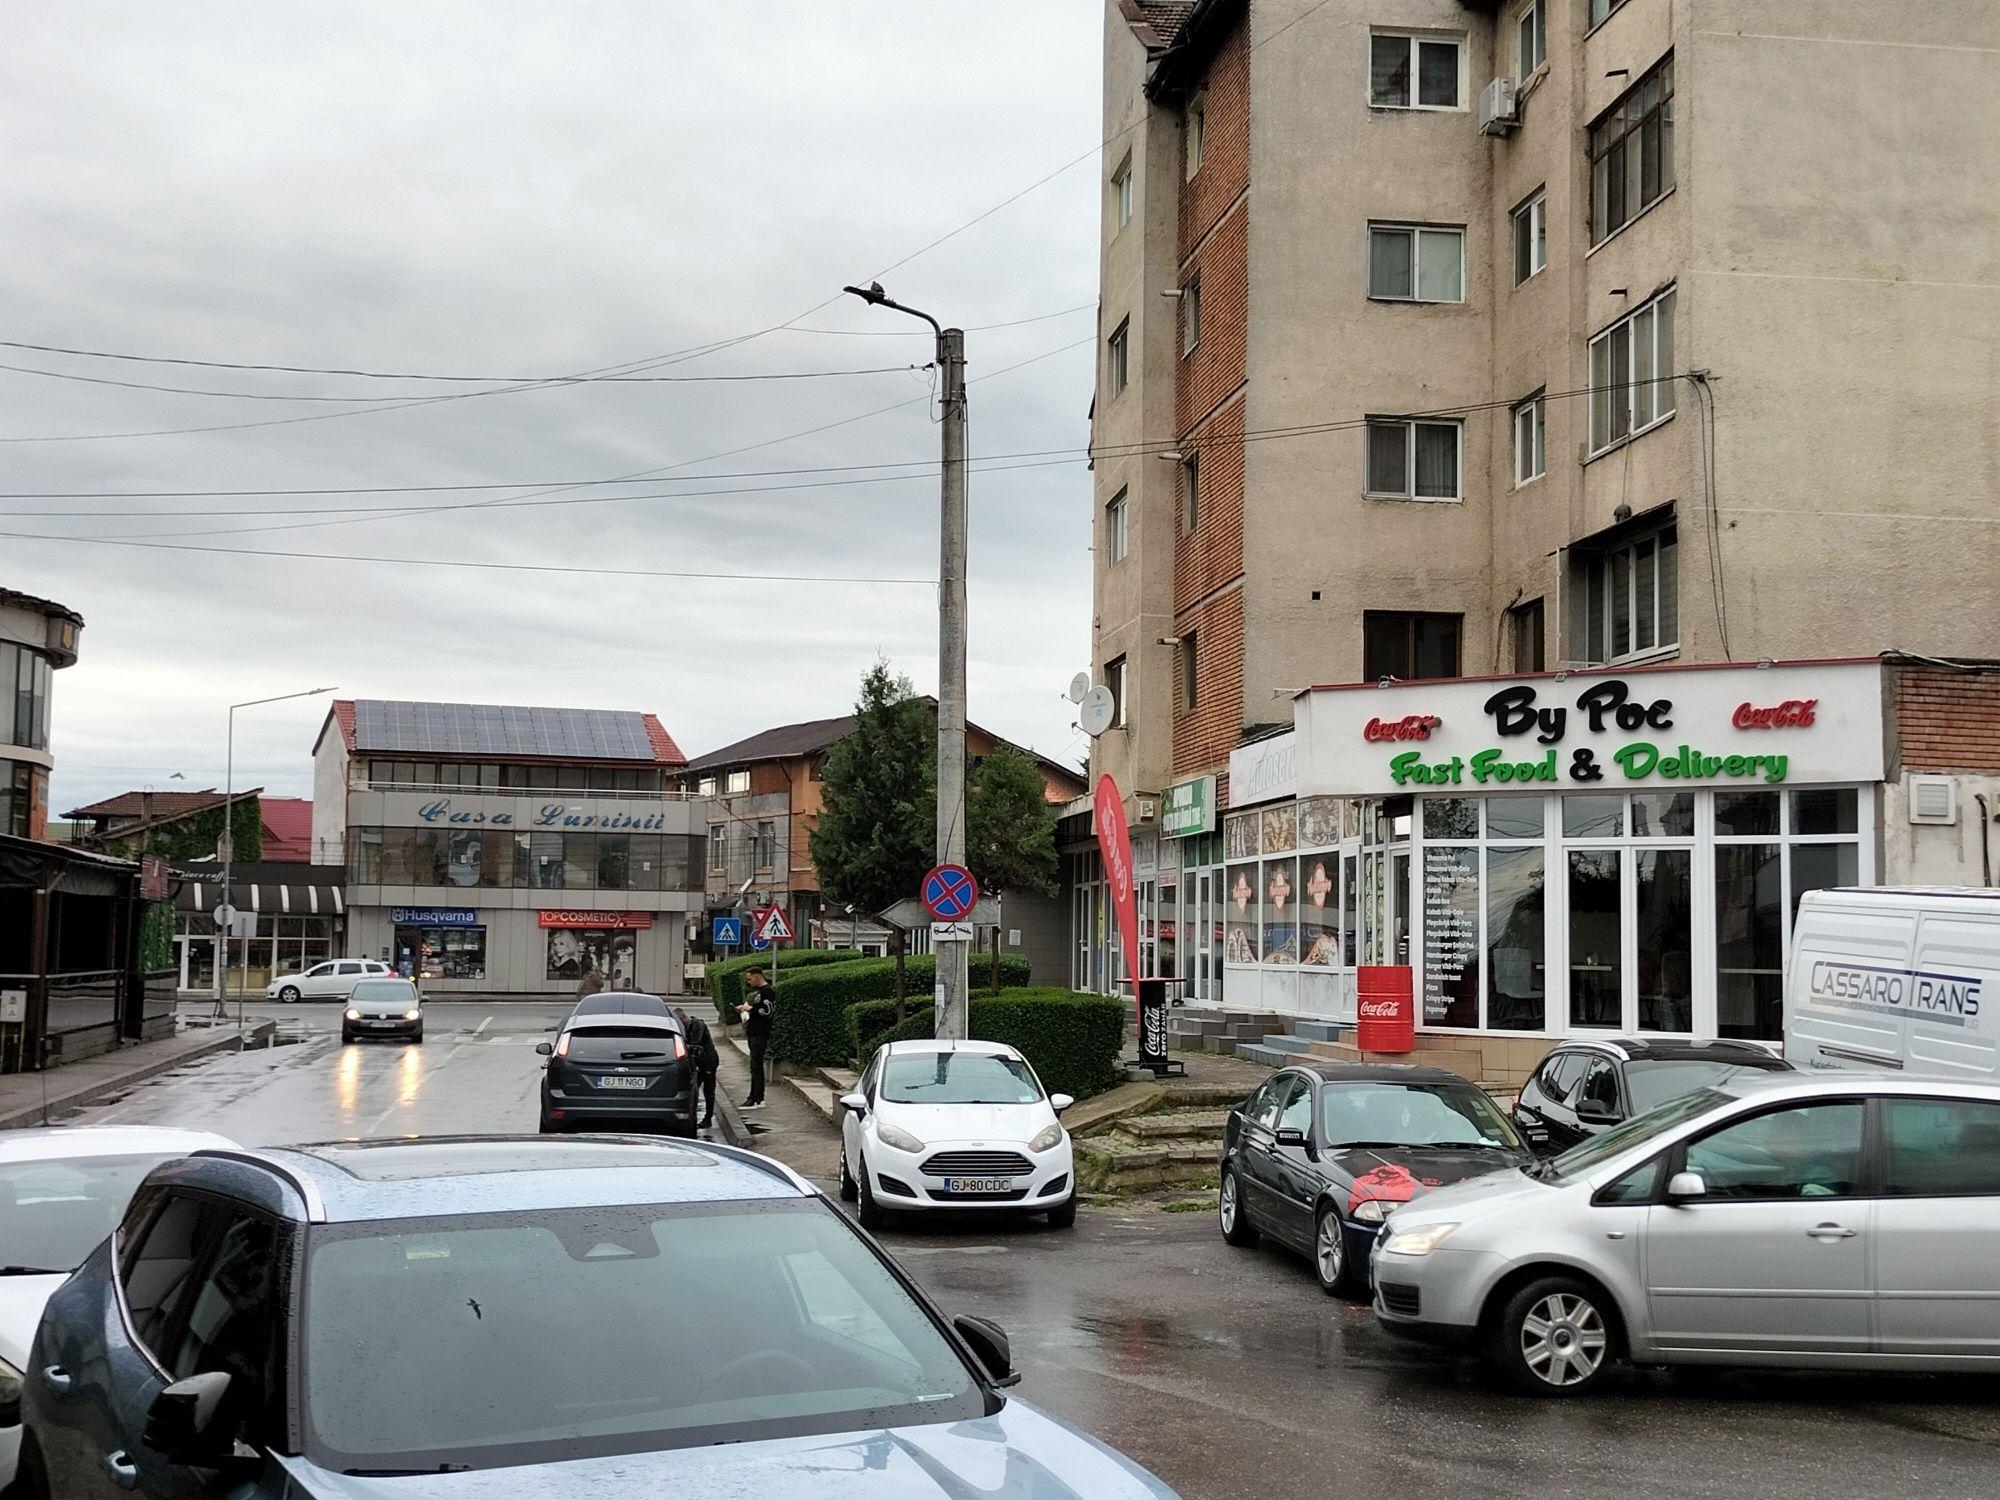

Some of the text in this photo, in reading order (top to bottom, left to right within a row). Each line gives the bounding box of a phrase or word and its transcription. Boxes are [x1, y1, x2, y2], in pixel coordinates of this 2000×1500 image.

[1484, 679, 1673, 744] By Poc
[1390, 742, 1789, 785] Fast Food & Delivery
[418, 799, 666, 830] Casa Luminii
[405, 910, 474, 923] Husqvarna
[1811, 960, 1903, 1005] CASSARO
[604, 1077, 644, 1087] GJ 11 NGO
[951, 1179, 1009, 1191] GJ 80 CDC
